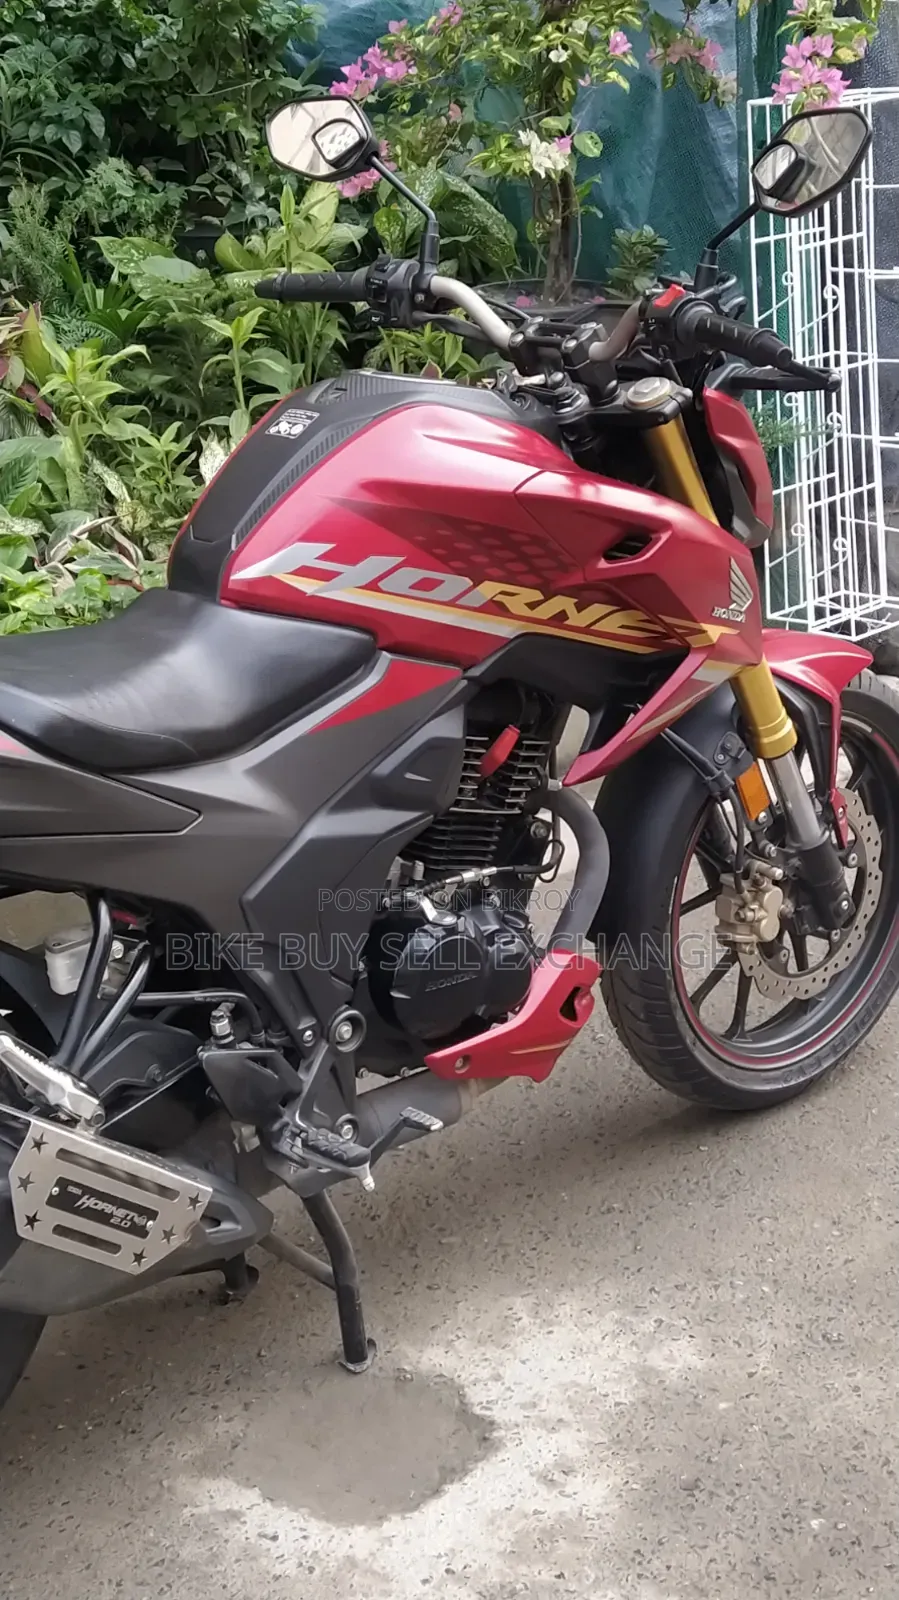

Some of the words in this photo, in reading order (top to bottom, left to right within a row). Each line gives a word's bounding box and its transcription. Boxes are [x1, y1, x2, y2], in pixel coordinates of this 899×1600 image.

[712, 606, 746, 623] HONDA
[73, 1194, 138, 1220] HORNET
[110, 1216, 132, 1228] 2.0
